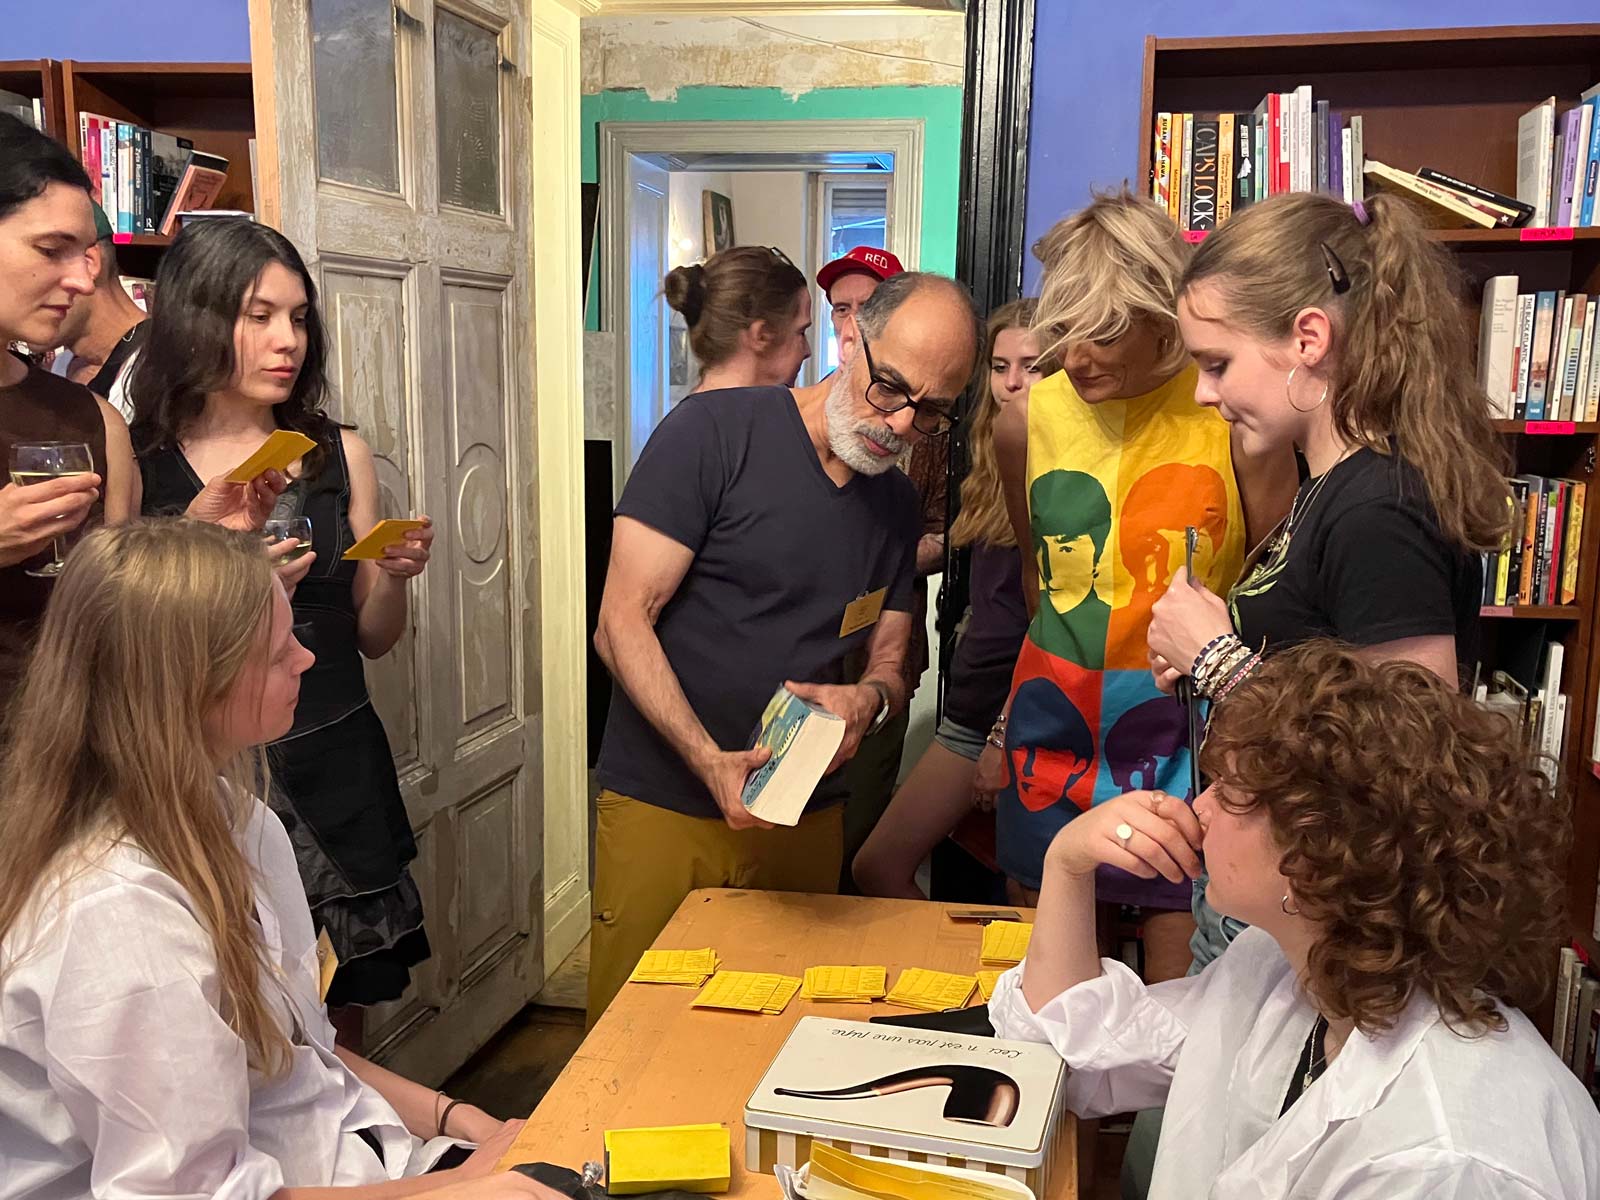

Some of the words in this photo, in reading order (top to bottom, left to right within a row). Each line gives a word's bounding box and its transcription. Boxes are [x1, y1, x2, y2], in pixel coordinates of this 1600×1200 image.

[134, 147, 142, 163] Zyta
[1195, 128, 1216, 173] CAPS
[1160, 142, 1168, 178] ABULHAWA
[1193, 175, 1214, 224] LOCK
[864, 252, 889, 269] RED
[1523, 311, 1531, 331] BLACK
[1521, 332, 1529, 362] ATLANTIC
[1537, 542, 1545, 557] DON
[873, 1033, 903, 1042] une
[908, 1036, 939, 1050] pas
